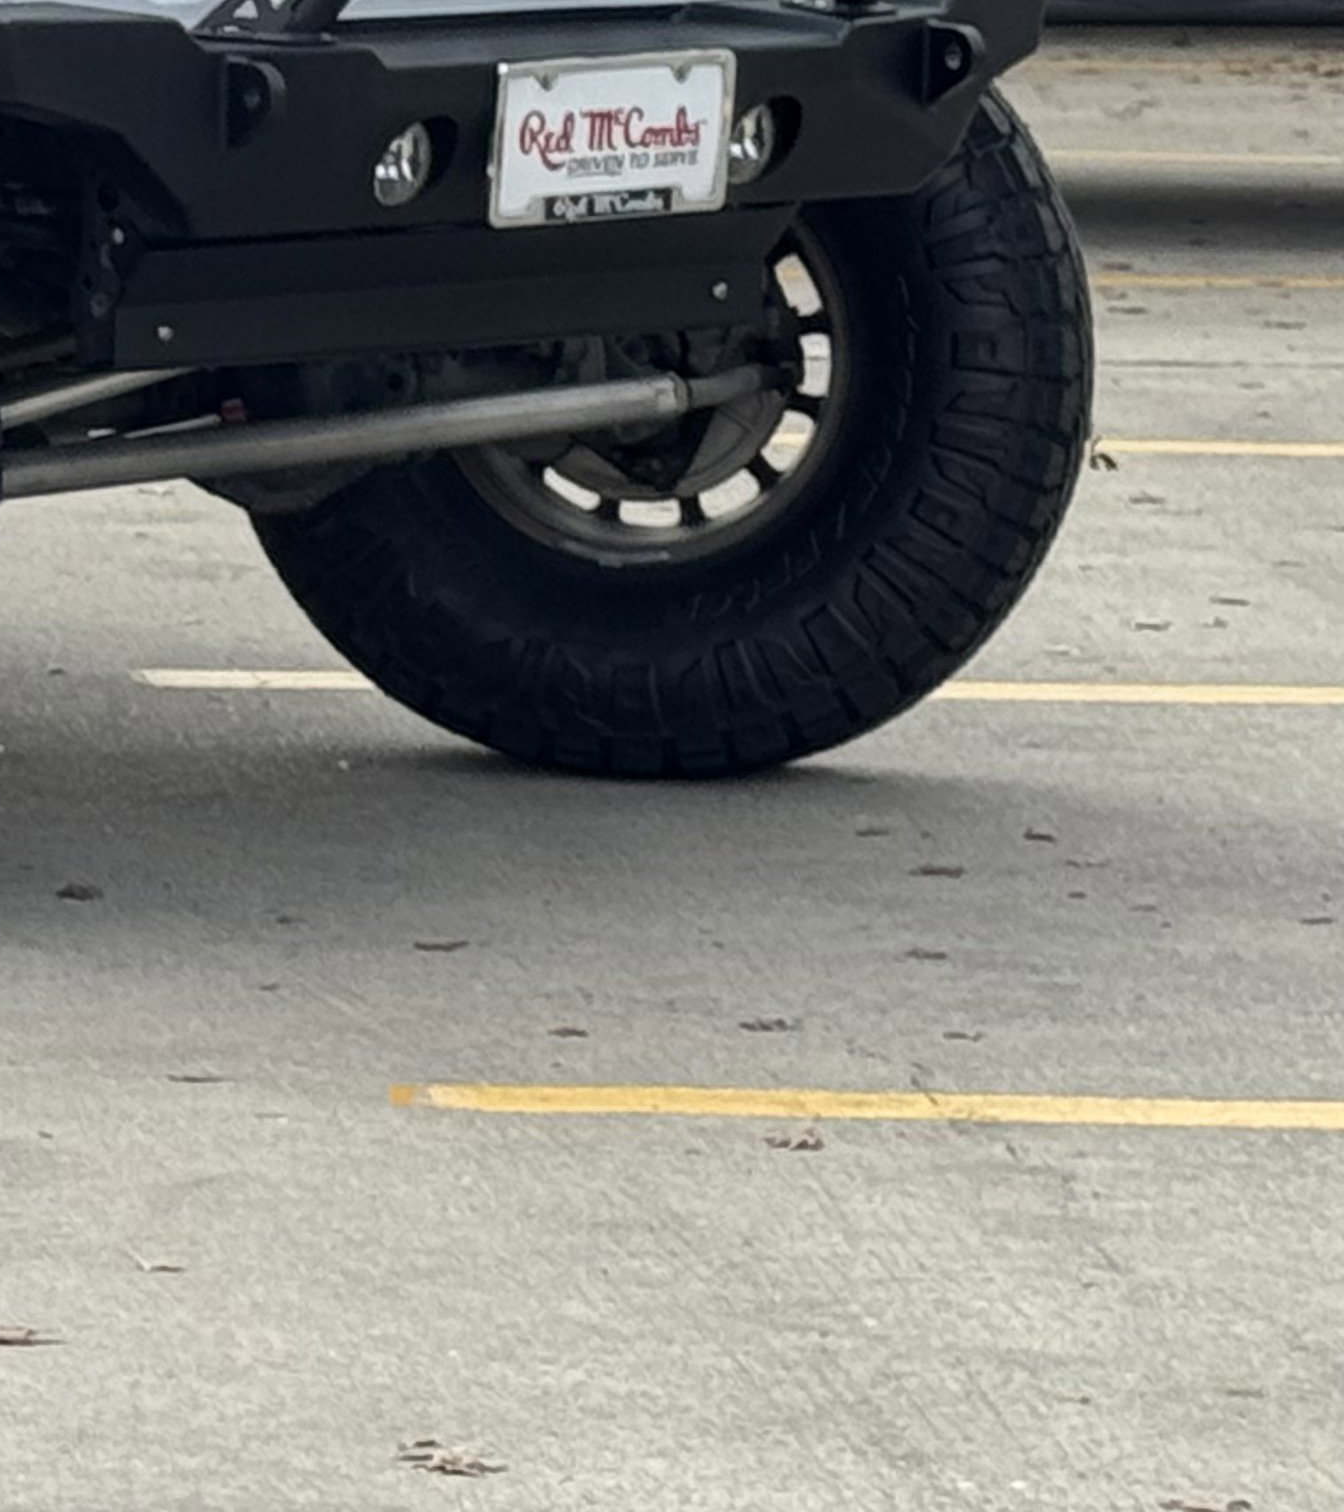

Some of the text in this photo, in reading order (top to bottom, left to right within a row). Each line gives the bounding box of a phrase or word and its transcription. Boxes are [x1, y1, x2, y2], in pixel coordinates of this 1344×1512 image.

[519, 103, 701, 172] Red McCombs
[566, 148, 699, 175] DRIVEN TO SERVE
